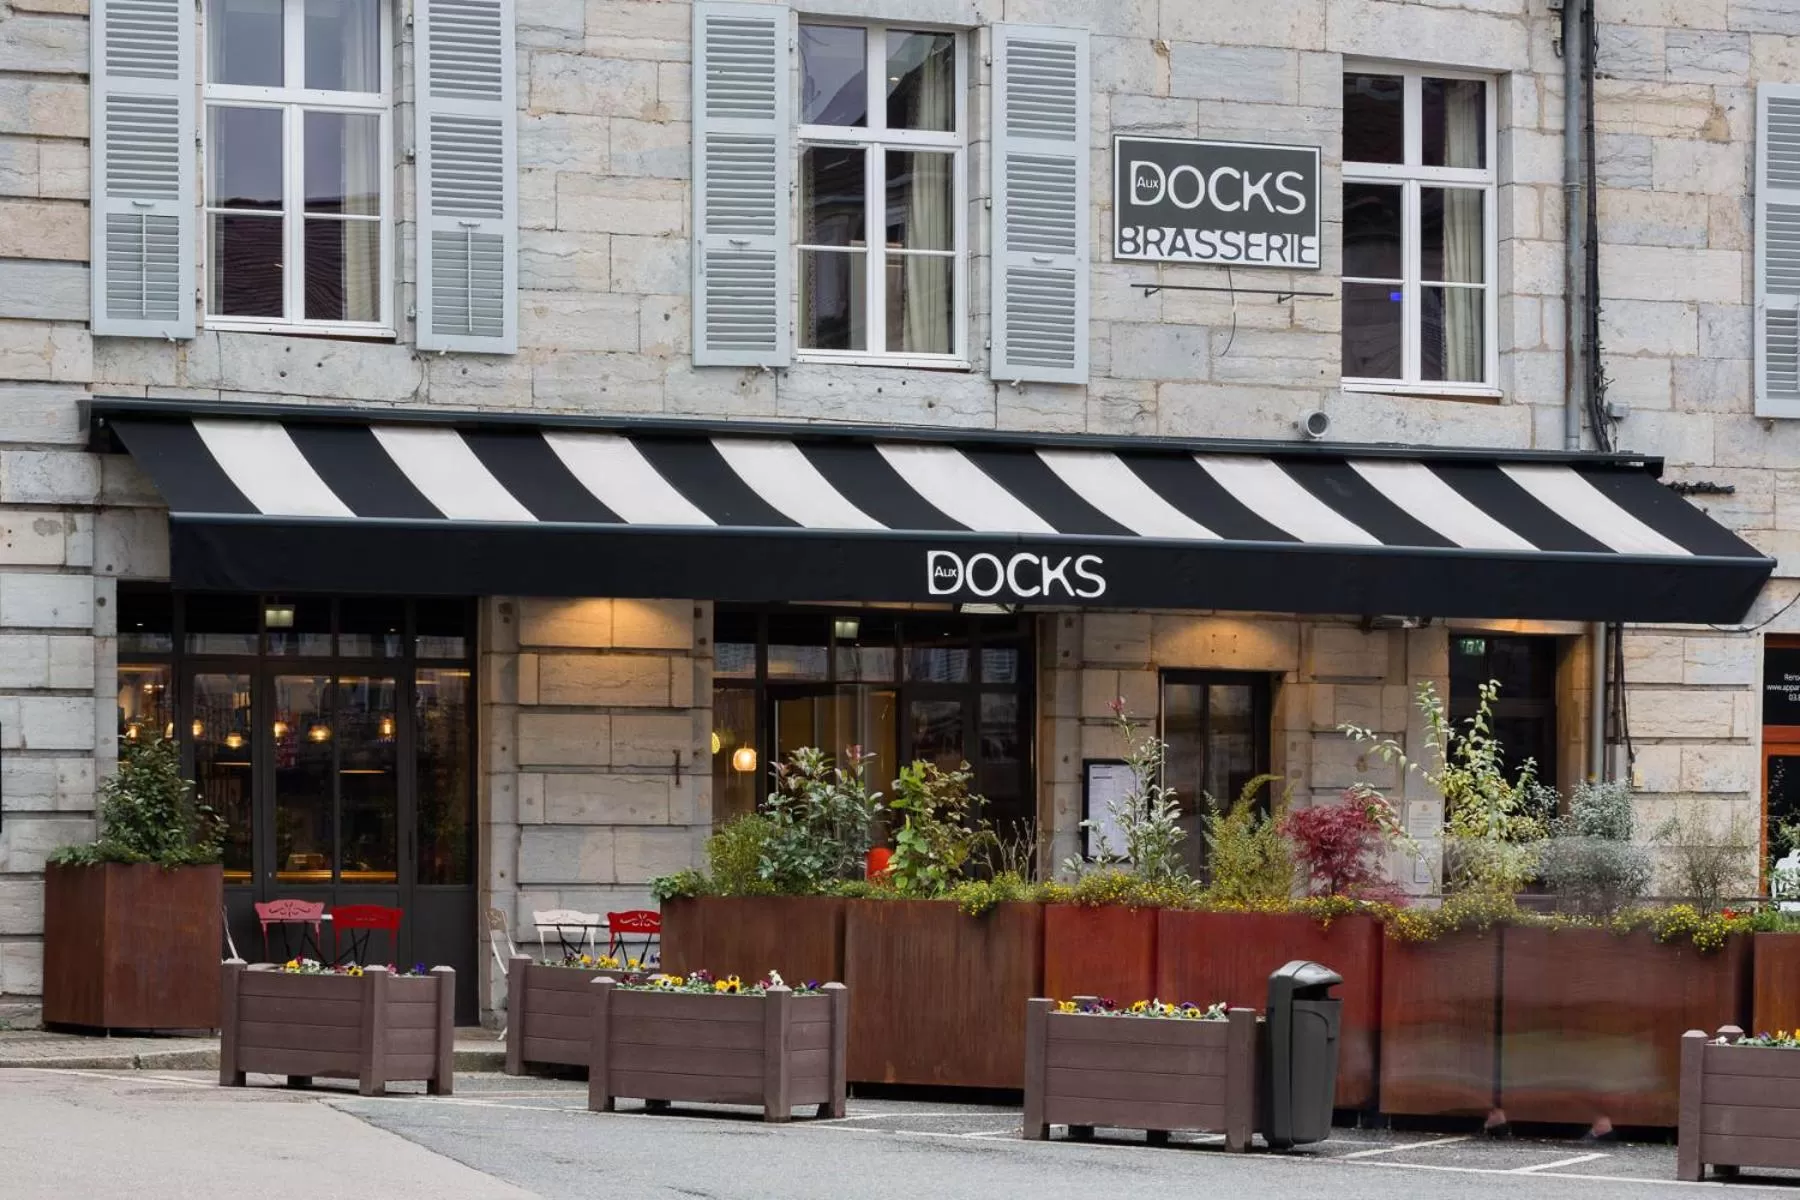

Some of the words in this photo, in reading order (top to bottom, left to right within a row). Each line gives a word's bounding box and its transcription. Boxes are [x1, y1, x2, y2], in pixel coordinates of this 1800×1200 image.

[1129, 160, 1307, 215] DOCKS
[1136, 175, 1160, 189] Aux
[1119, 226, 1317, 264] BRASSERIE
[927, 550, 1107, 598] DOCKS
[934, 565, 957, 578] Aux
